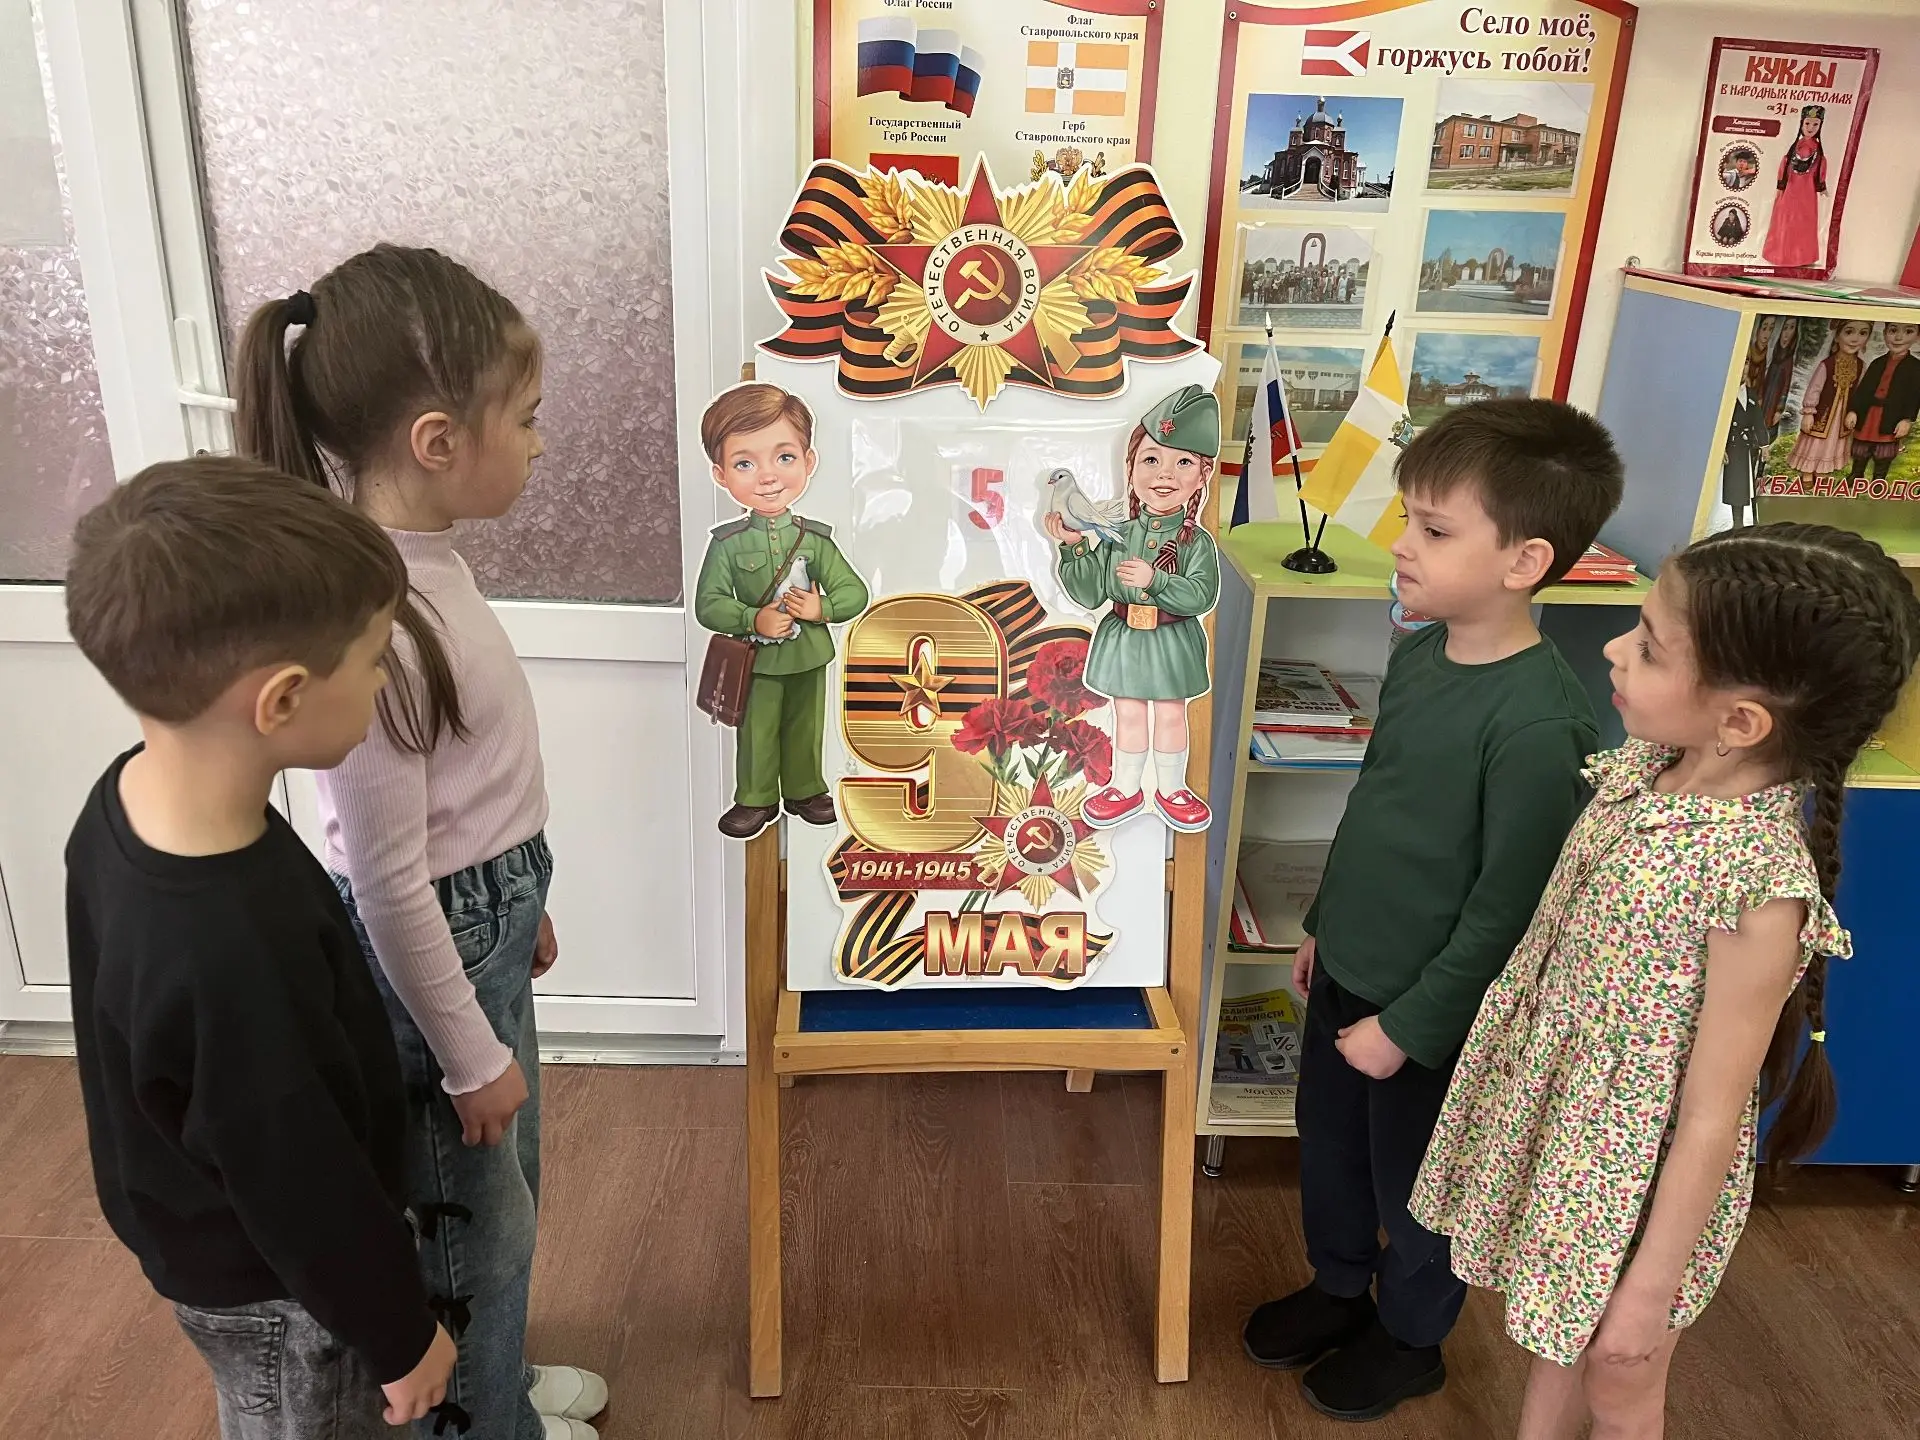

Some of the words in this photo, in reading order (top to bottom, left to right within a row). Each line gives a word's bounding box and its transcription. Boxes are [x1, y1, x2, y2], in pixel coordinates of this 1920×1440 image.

[1067, 14, 1094, 26] Флаг
[1459, 7, 1530, 35] Село
[1537, 13, 1596, 43] моё,
[1020, 25, 1111, 39] Ставропольского
[1114, 31, 1139, 42] края
[1376, 48, 1491, 75] горжусь
[1501, 46, 1591, 73] тобой!
[1744, 55, 1838, 88] КУКЛЫ
[1720, 83, 1728, 95] В
[1730, 84, 1788, 100] НАРОДНЫХ
[1789, 89, 1853, 105] КОСТЮМАХ
[1774, 102, 1788, 116] 31
[869, 116, 961, 129] Государственный
[1062, 121, 1086, 132] Герб
[883, 130, 907, 143] Герб
[911, 132, 947, 143] России
[1015, 130, 1104, 144] Ставропольского
[1106, 136, 1131, 146] края
[928, 229, 1026, 332] ОТЕЧЕСТВЕННАЯ
[1003, 268, 1037, 332] ВОЙНА
[968, 467, 1004, 530] 5
[840, 593, 1009, 853] 9
[1006, 808, 1068, 867] ОТЕЧЕСТВЕННАЯ
[850, 860, 972, 881] 1941-1945
[925, 911, 1087, 976] МАЯ
